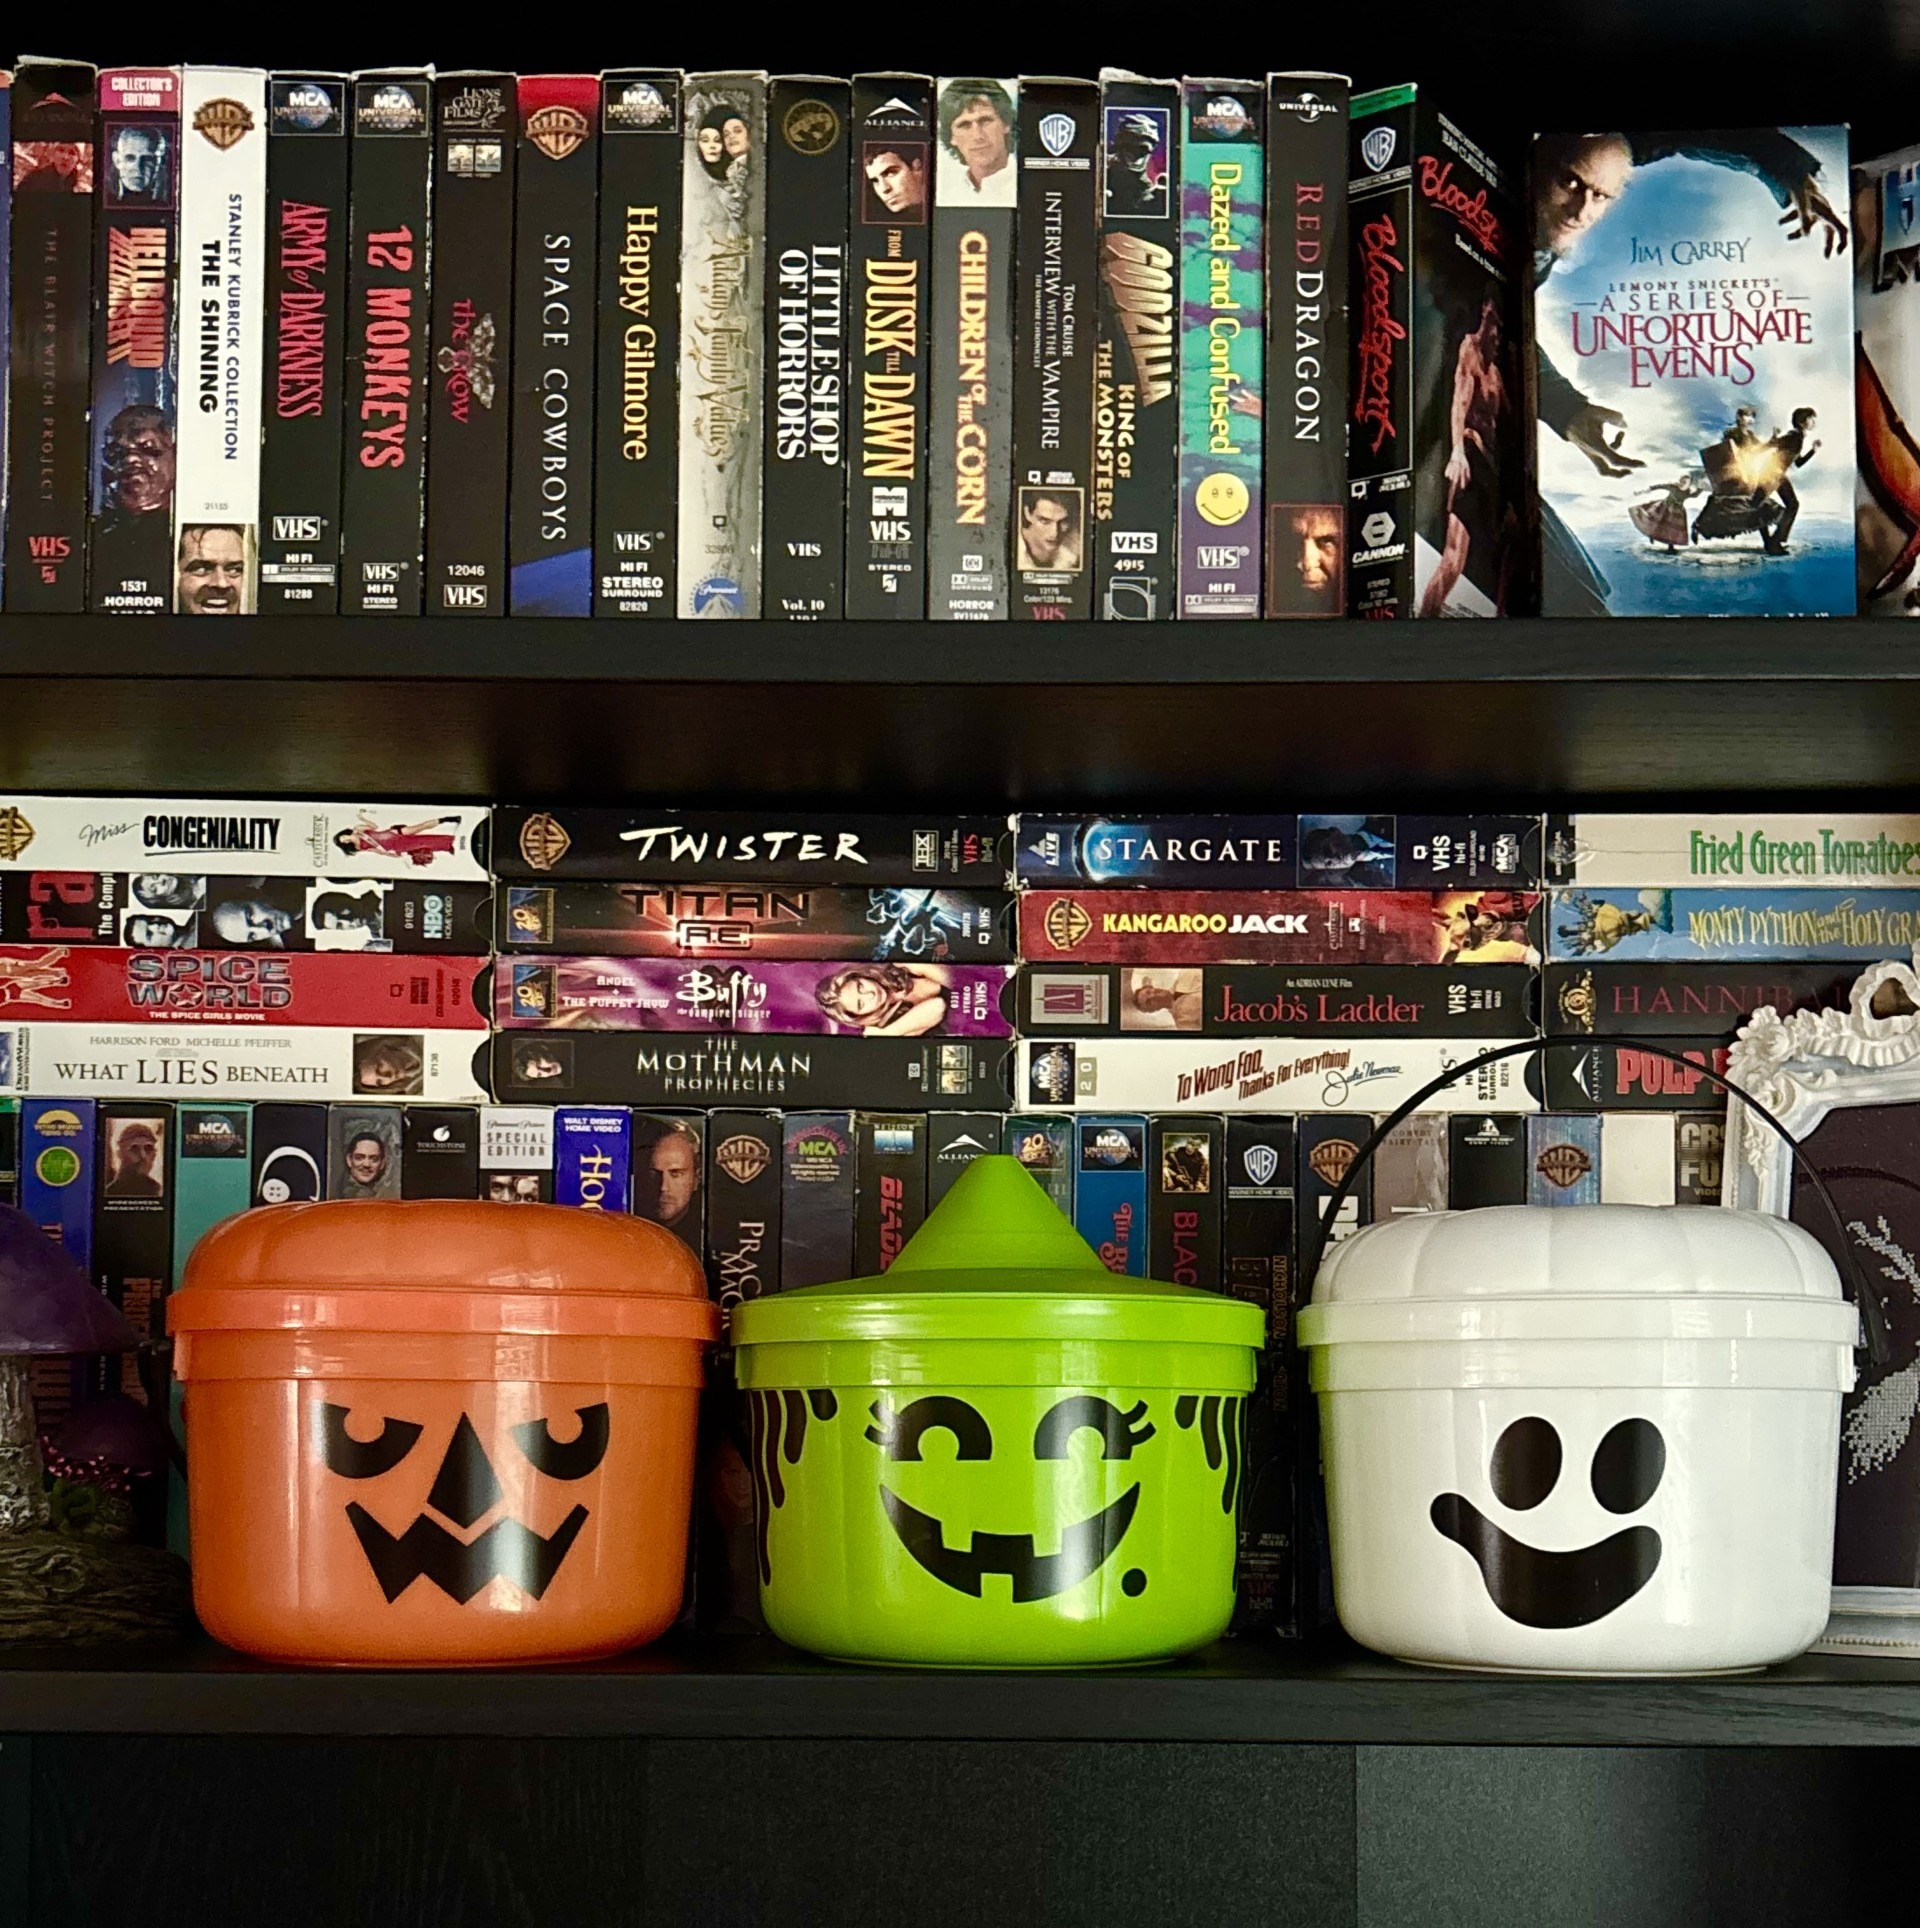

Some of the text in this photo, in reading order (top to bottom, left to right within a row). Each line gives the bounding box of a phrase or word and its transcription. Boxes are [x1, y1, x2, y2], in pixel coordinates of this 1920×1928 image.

[111, 77, 173, 92] COLLECTOR'S
[623, 91, 659, 104] MCA
[122, 92, 161, 107] EDITION
[289, 91, 328, 106] MCA
[374, 94, 411, 108] MCA
[1207, 103, 1242, 116] MCA
[863, 119, 926, 127] ALLIANCE
[280, 199, 332, 274] ARMY
[1631, 238, 1752, 265] JIM CARREY
[107, 227, 132, 346] HELLRAISER
[129, 228, 167, 368] HELLBOUND
[1609, 278, 1772, 293] LEMONY SNICKET'S
[43, 275, 58, 334] BLAIR
[959, 231, 988, 380] CHILDREN
[1209, 162, 1242, 454] Dazed and Confused
[1295, 182, 1324, 442] RED DRAGON
[1600, 290, 1783, 312] A SERIES OF
[199, 240, 221, 414] THE SHINING
[224, 193, 242, 460] STANLEY KUBRICK COLLECTION
[1042, 192, 1062, 449] INTERVIEW WITH THE VAMPIRE
[1062, 284, 1075, 358] TOM CRUISE
[1105, 232, 1173, 407] GODZILLA
[619, 206, 658, 460] Happy Gilmore
[1570, 309, 1813, 357] UNFORTUNATE
[276, 292, 328, 418] DARKNESS
[360, 225, 413, 468] 12 MONKEYS
[777, 249, 809, 460] OF HORRORS
[863, 229, 917, 480] FROM DUSK TILL DAWN
[42, 344, 56, 406] WITCH
[1630, 342, 1755, 388] EVENTS
[541, 234, 571, 540] SPACE COWBOYS
[1117, 384, 1136, 479] KING OF
[40, 417, 55, 502] PROJECT
[1096, 384, 1115, 520] MONSTERS
[956, 424, 987, 525] CORN
[276, 518, 319, 539] VHS
[870, 521, 911, 541] VHS
[29, 536, 71, 556] VHS
[616, 533, 651, 551] VHS
[787, 543, 822, 557] VHS
[1114, 537, 1155, 550] VHS
[1352, 545, 1406, 564] CANNON
[448, 565, 485, 576] 12046
[1114, 559, 1145, 571] 4915
[1200, 548, 1238, 567] VHS
[365, 565, 398, 580] VHS
[602, 577, 663, 588] STEREO
[120, 581, 147, 592] 1531
[447, 587, 485, 606] VHS
[104, 596, 164, 607] HORROR
[782, 599, 825, 610] Vol. 10
[949, 601, 994, 610] HORROR
[79, 815, 280, 850] Miss CONGENIALITY
[619, 826, 869, 865] TWISTER
[963, 834, 978, 865] VHS
[1099, 838, 1281, 861] STARGATE
[1432, 835, 1451, 871] VHS
[1690, 830, 1743, 874] Fried
[1750, 830, 1816, 874] Green
[423, 895, 443, 939] HBO
[621, 889, 810, 920] TITAN
[1103, 913, 1227, 934] KANGAROO
[1228, 913, 1309, 934] JACK
[1688, 904, 1747, 950] MONTY
[1749, 905, 1818, 947] PYTHON
[1841, 906, 1889, 947] HOLY
[128, 953, 292, 985] SPICE
[597, 975, 636, 986] ANGEL
[130, 982, 292, 1010] WORLD
[563, 996, 669, 1009] THE PUPPET SHOW
[676, 969, 767, 1027] Buffy
[1213, 985, 1425, 1023] Jacob's Ladder
[1449, 984, 1467, 1014] VHS
[688, 1008, 731, 1021] vampire
[737, 1008, 771, 1022] slayer
[90, 1036, 292, 1048] HARRISON FORD MICHELLE PFEIFFER
[705, 1039, 738, 1050] THE
[54, 1059, 329, 1085] WHAT LIES BENEATH
[637, 1053, 811, 1075] MOTHMAN
[1038, 1055, 1051, 1089] MCA
[1176, 1049, 1264, 1103] To Wong Foo,
[1238, 1048, 1352, 1101] Thanks For Everything!
[1615, 1048, 1706, 1094] PULP
[663, 1077, 786, 1091] PROPHECIES
[199, 1122, 231, 1134] MCA
[590, 1118, 623, 1126] DISNEY
[594, 1125, 622, 1133] VIDEO
[416, 1141, 466, 1150] TOUCHSTONE
[487, 1132, 547, 1144] SPECIAL
[799, 1141, 837, 1156] MCA
[1096, 1135, 1127, 1147] MCA
[487, 1146, 545, 1157] EDITION
